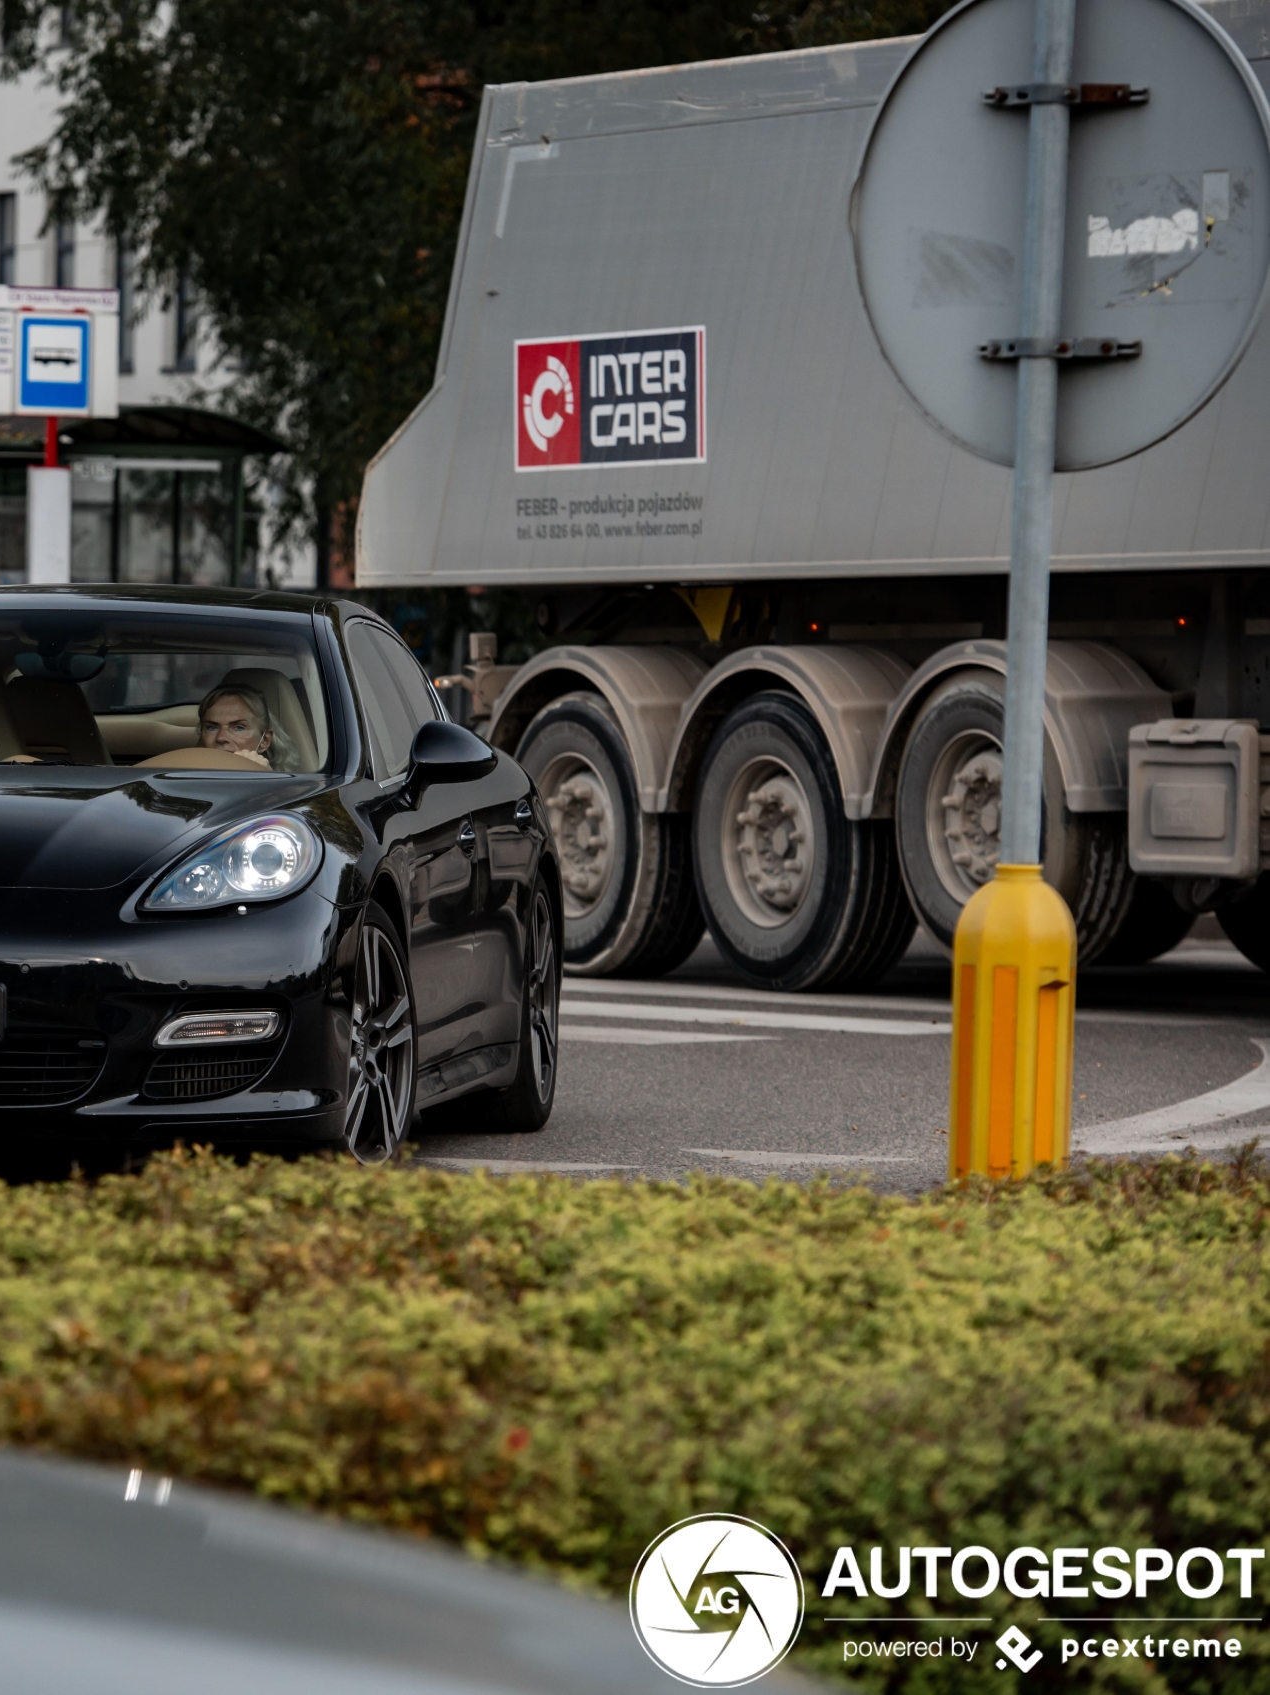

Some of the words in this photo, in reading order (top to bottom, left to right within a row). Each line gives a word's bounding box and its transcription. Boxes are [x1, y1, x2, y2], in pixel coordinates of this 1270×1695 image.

[590, 348, 687, 398] INTER
[590, 399, 687, 447] CARS
[516, 498, 558, 517] FEBER
[569, 494, 635, 519] produkcja
[638, 491, 703, 517] pojazdów
[517, 525, 534, 540] tel.
[536, 524, 548, 539] 43
[604, 519, 703, 538] www.feber.com.pl
